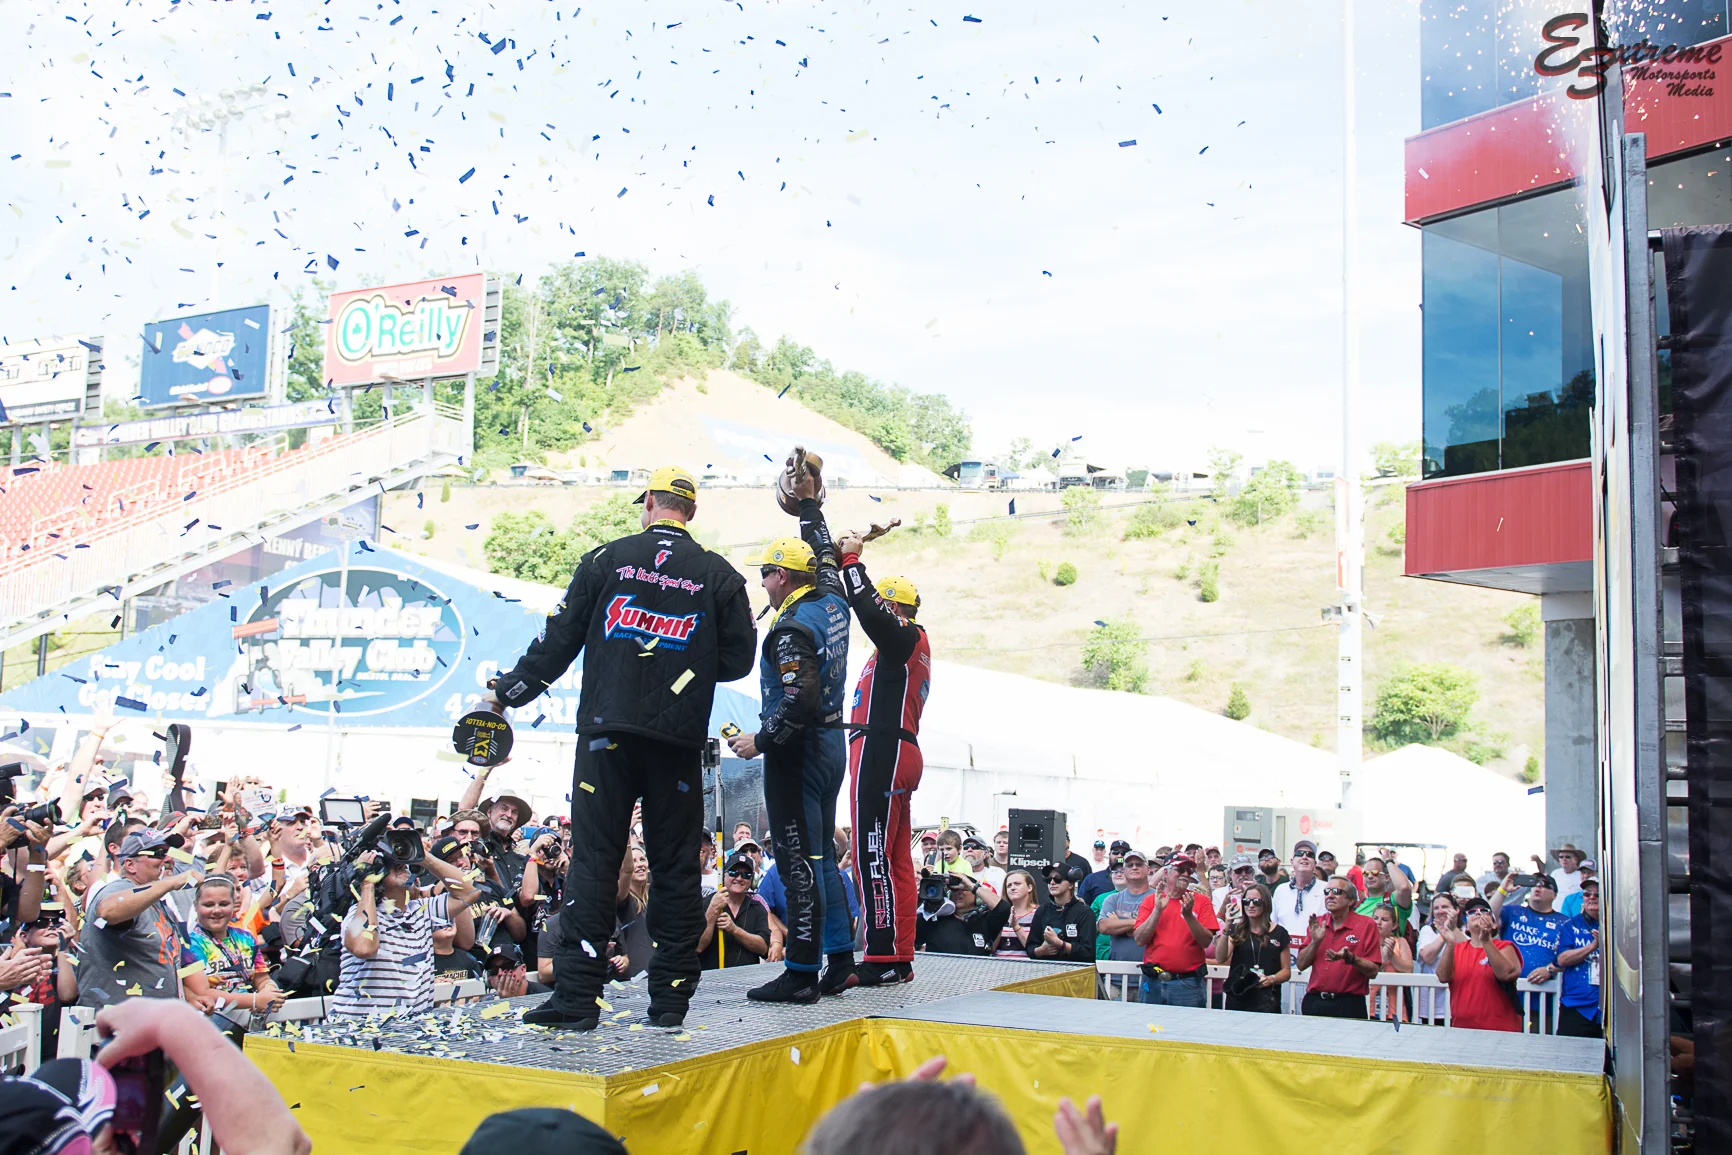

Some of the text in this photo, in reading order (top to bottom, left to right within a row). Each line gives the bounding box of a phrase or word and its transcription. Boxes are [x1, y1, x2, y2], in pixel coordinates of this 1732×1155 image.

[341, 302, 463, 354] O'Reilly
[303, 542, 333, 560] BER
[616, 565, 636, 580] The
[659, 575, 682, 590] Speed
[280, 596, 443, 639] Thunder
[88, 654, 207, 686] Stay Cool
[277, 640, 437, 680] Valley Club
[125, 685, 211, 711] Closer
[1009, 857, 1051, 868] Klipsch
